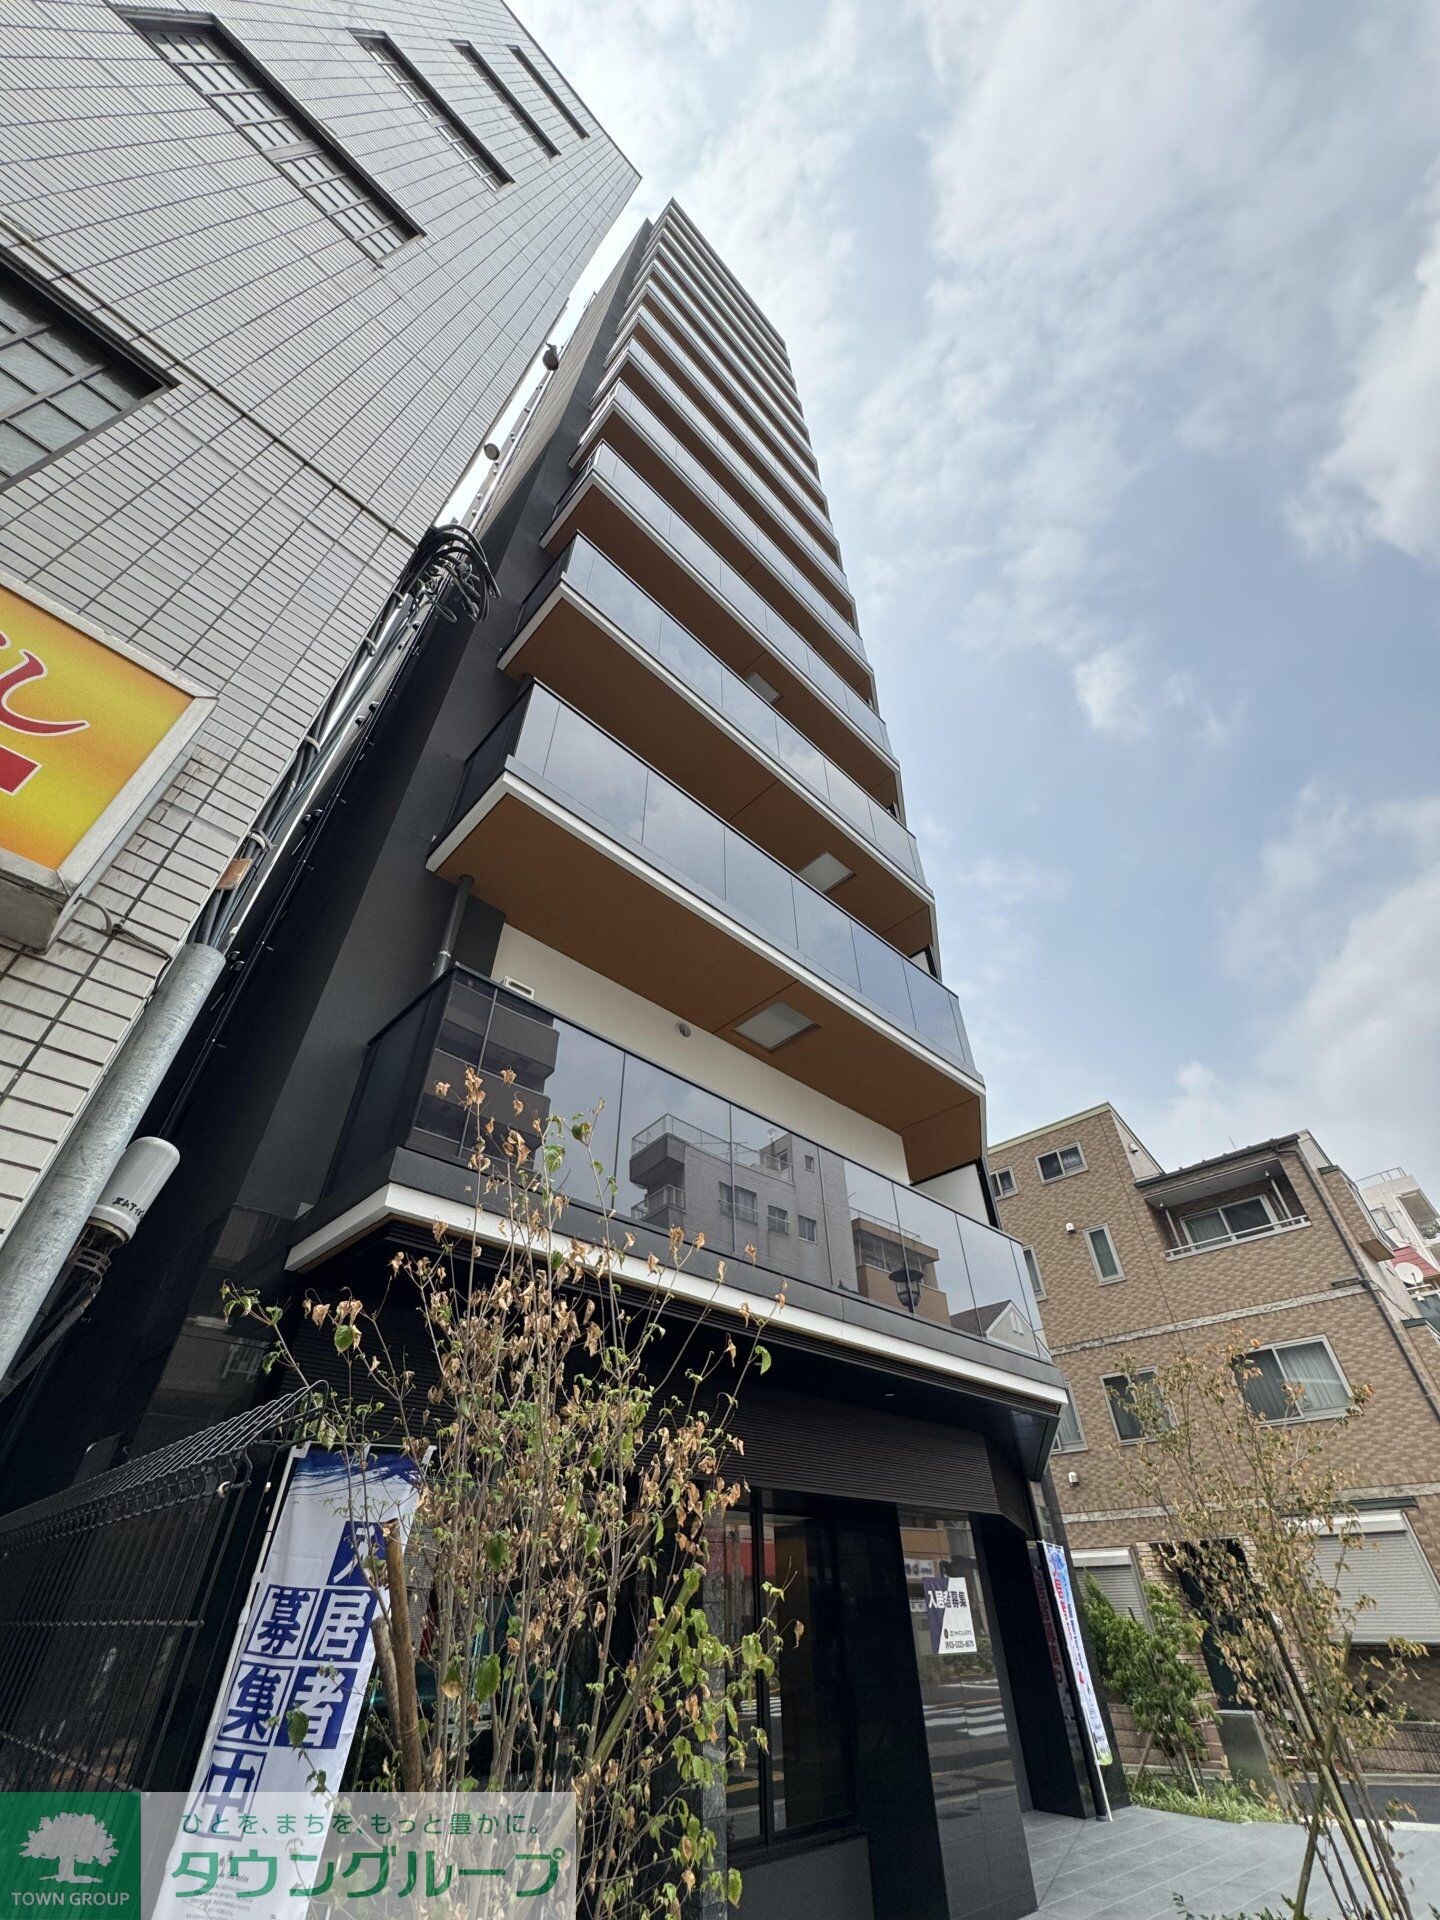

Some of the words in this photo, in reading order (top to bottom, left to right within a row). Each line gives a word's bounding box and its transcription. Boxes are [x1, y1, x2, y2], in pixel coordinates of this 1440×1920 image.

[928, 1590, 968, 1609] 入居者募集
[200, 1585, 312, 1832] 募集中
